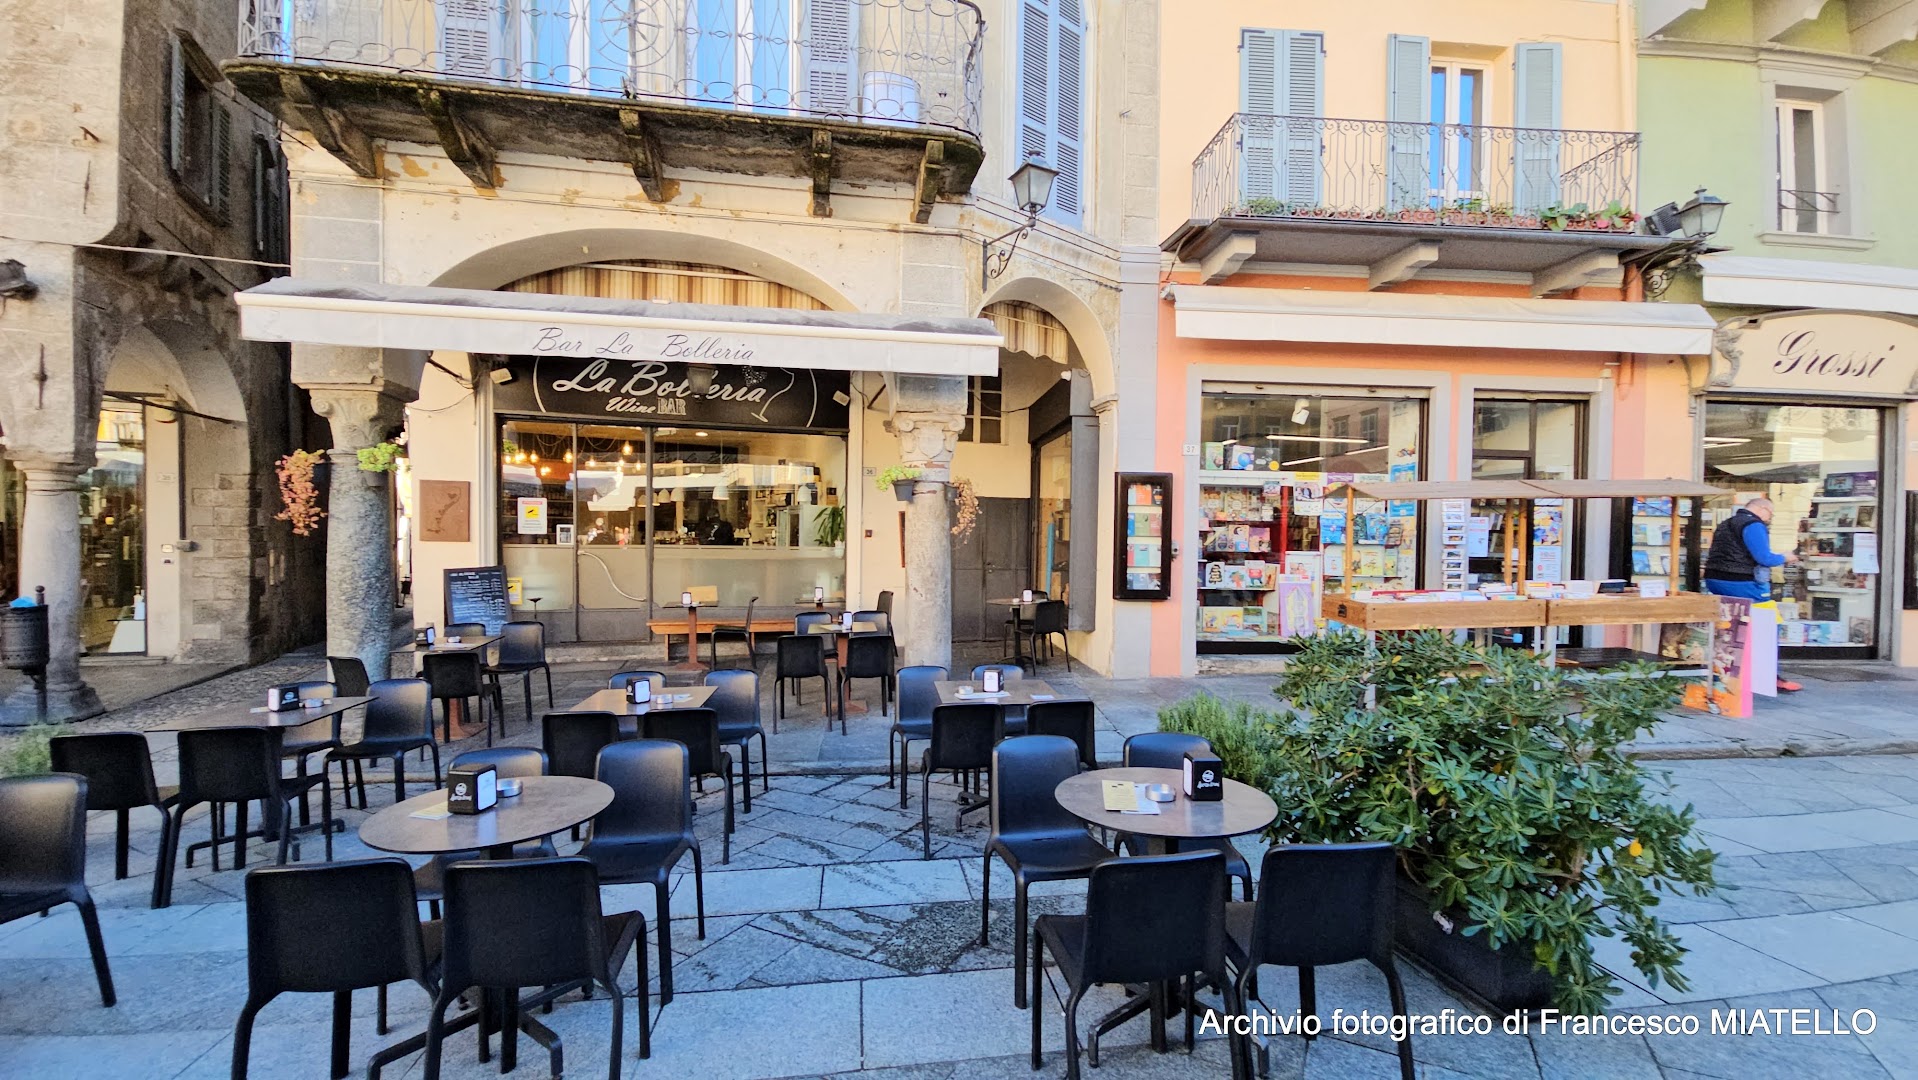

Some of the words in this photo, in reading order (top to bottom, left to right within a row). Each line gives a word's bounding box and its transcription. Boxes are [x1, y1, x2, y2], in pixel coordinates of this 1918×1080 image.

[532, 327, 582, 352] Bar
[595, 331, 634, 355] La
[660, 334, 754, 361] Bolleria
[1773, 330, 1896, 378] Grossi
[552, 359, 612, 393] La
[605, 397, 656, 414] Wine
[657, 398, 687, 416] BAR
